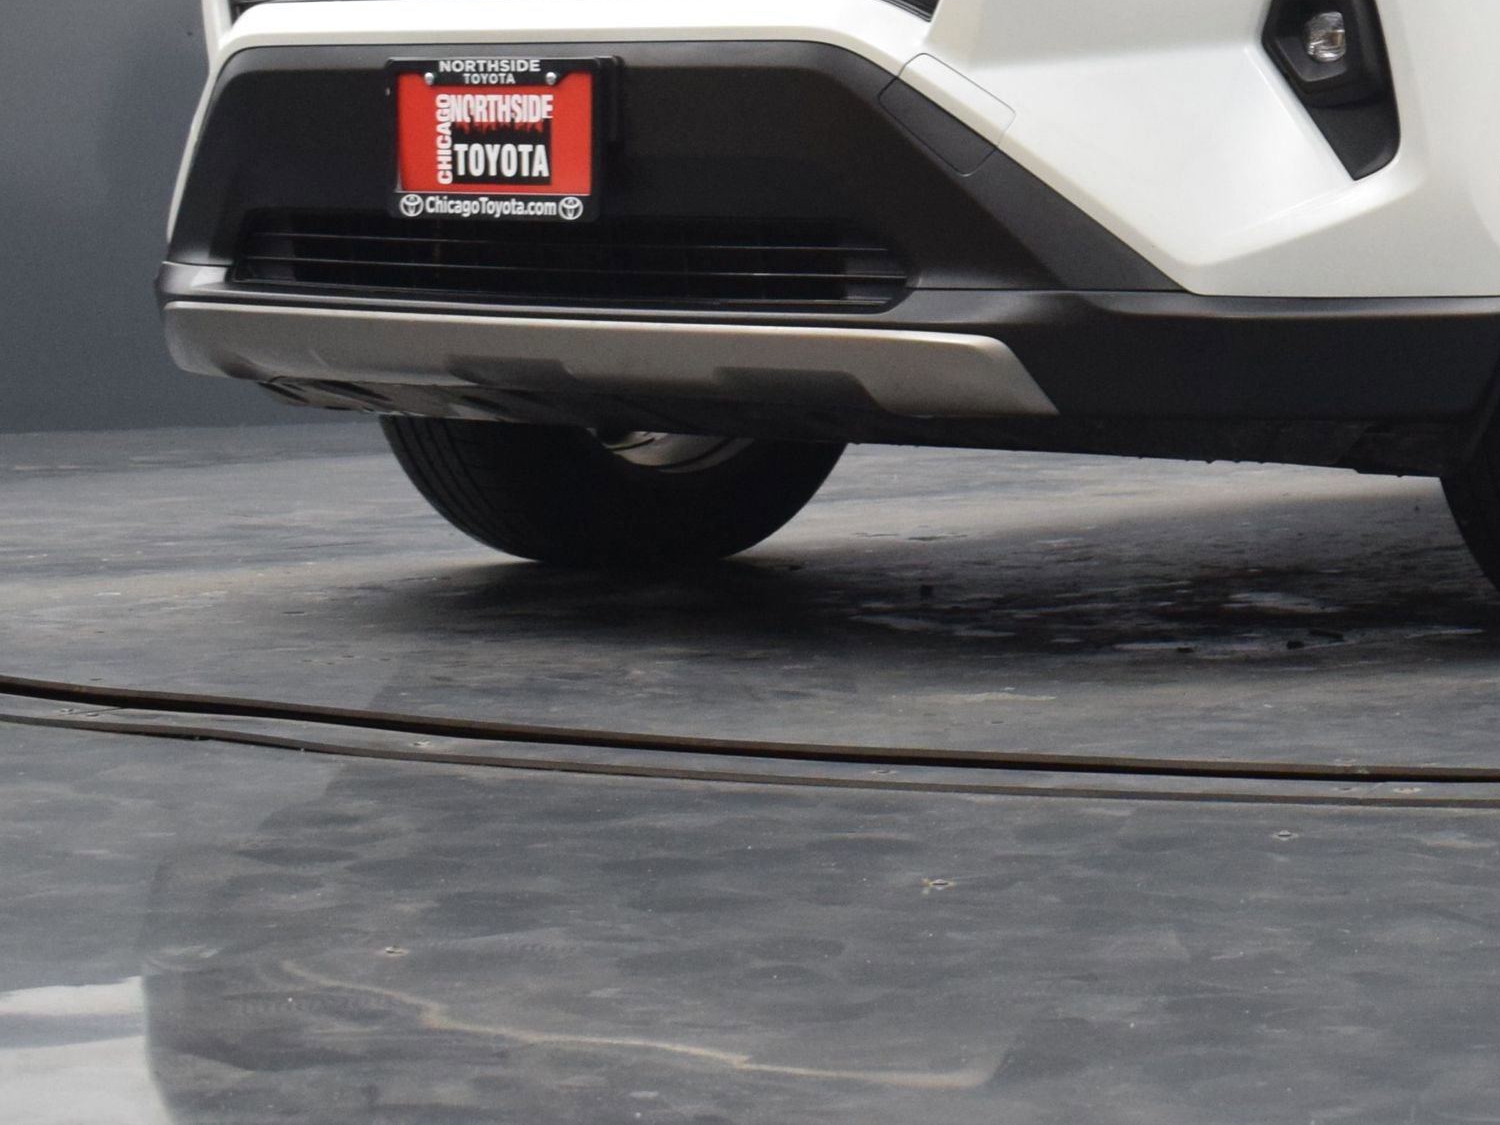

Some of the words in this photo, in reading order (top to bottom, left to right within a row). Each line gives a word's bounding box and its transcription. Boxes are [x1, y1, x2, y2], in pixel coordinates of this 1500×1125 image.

[438, 60, 541, 73] NORTHSIDE
[463, 74, 516, 85] TOYOTA
[450, 93, 554, 124] NORTHSIDE
[435, 93, 453, 185] CHICAGO
[453, 142, 550, 178] TOYOTA
[424, 196, 557, 217] ChicagoToyota.com
